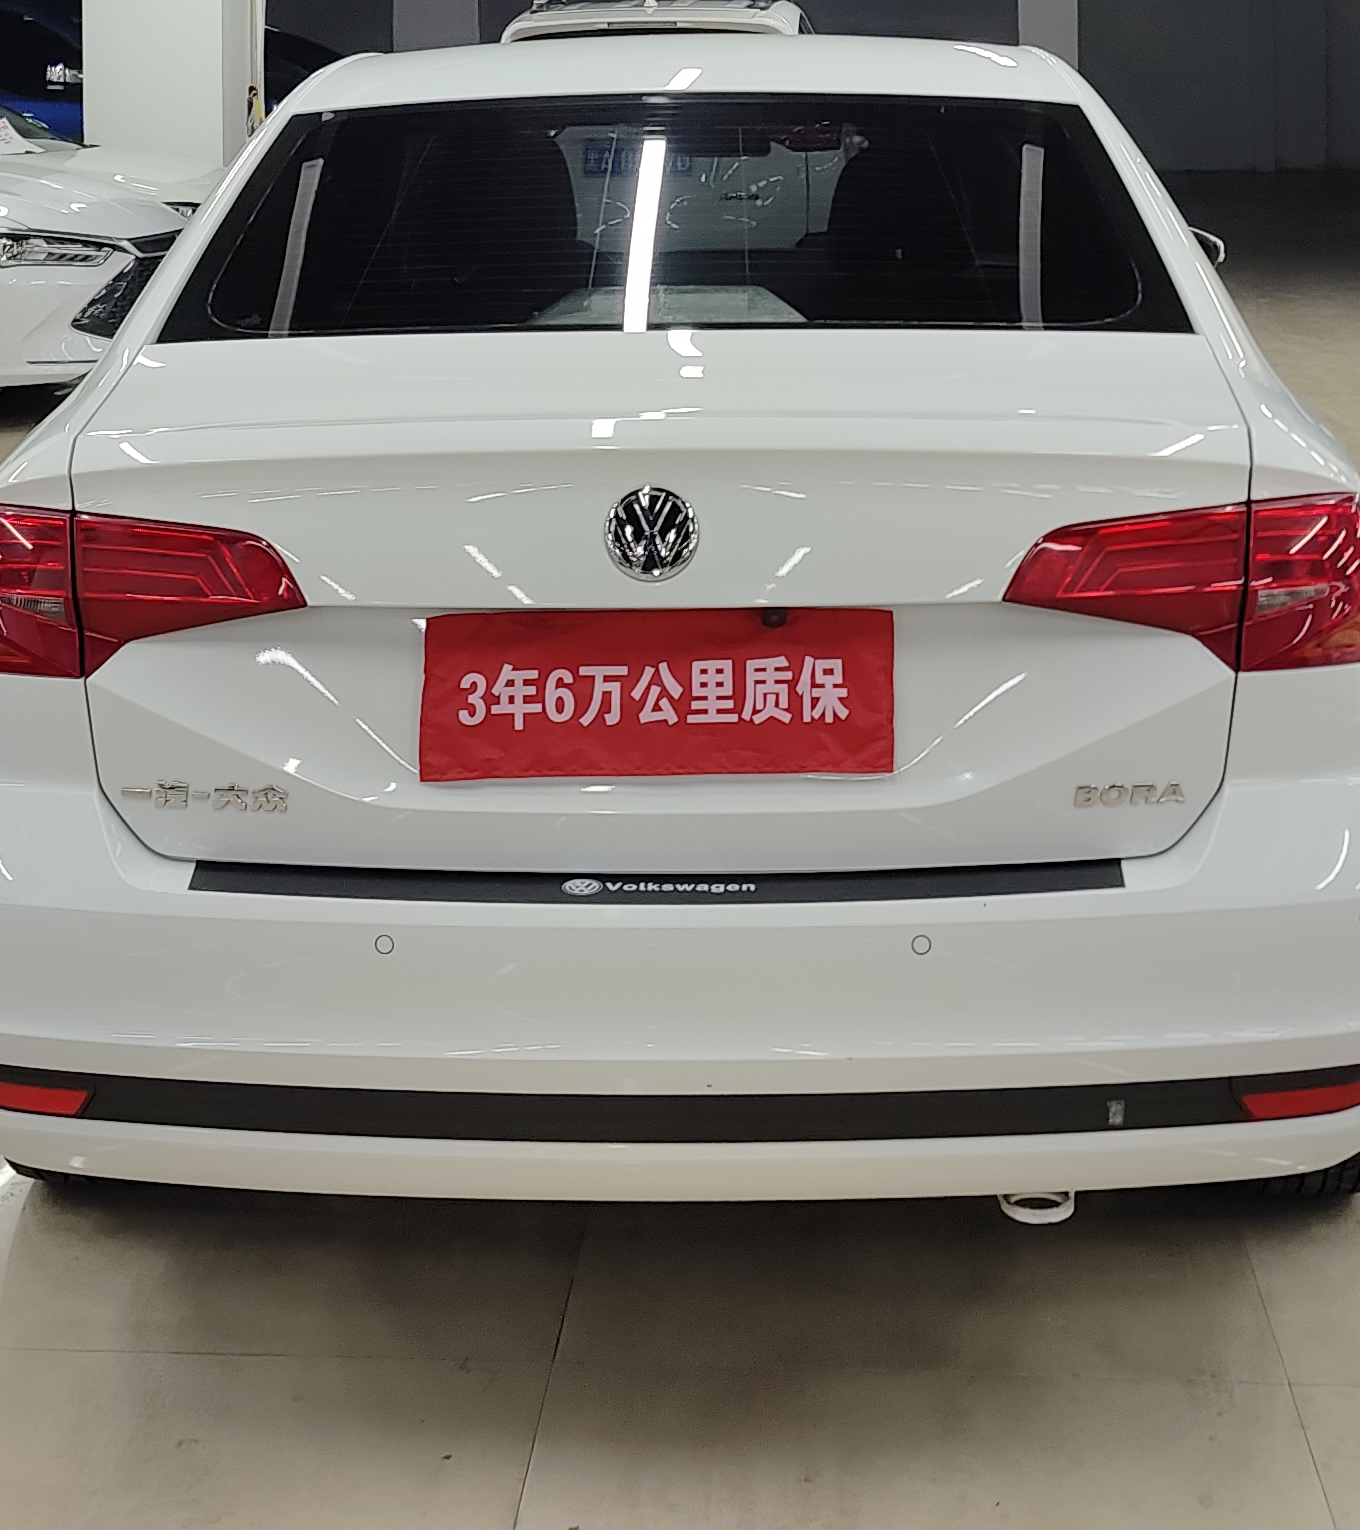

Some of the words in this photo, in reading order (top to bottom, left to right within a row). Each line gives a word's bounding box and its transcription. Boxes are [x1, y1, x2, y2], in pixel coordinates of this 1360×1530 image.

[457, 654, 851, 731] 3年6万公里质保
[1073, 781, 1186, 808] BORA
[604, 880, 757, 894] Volkswagen
